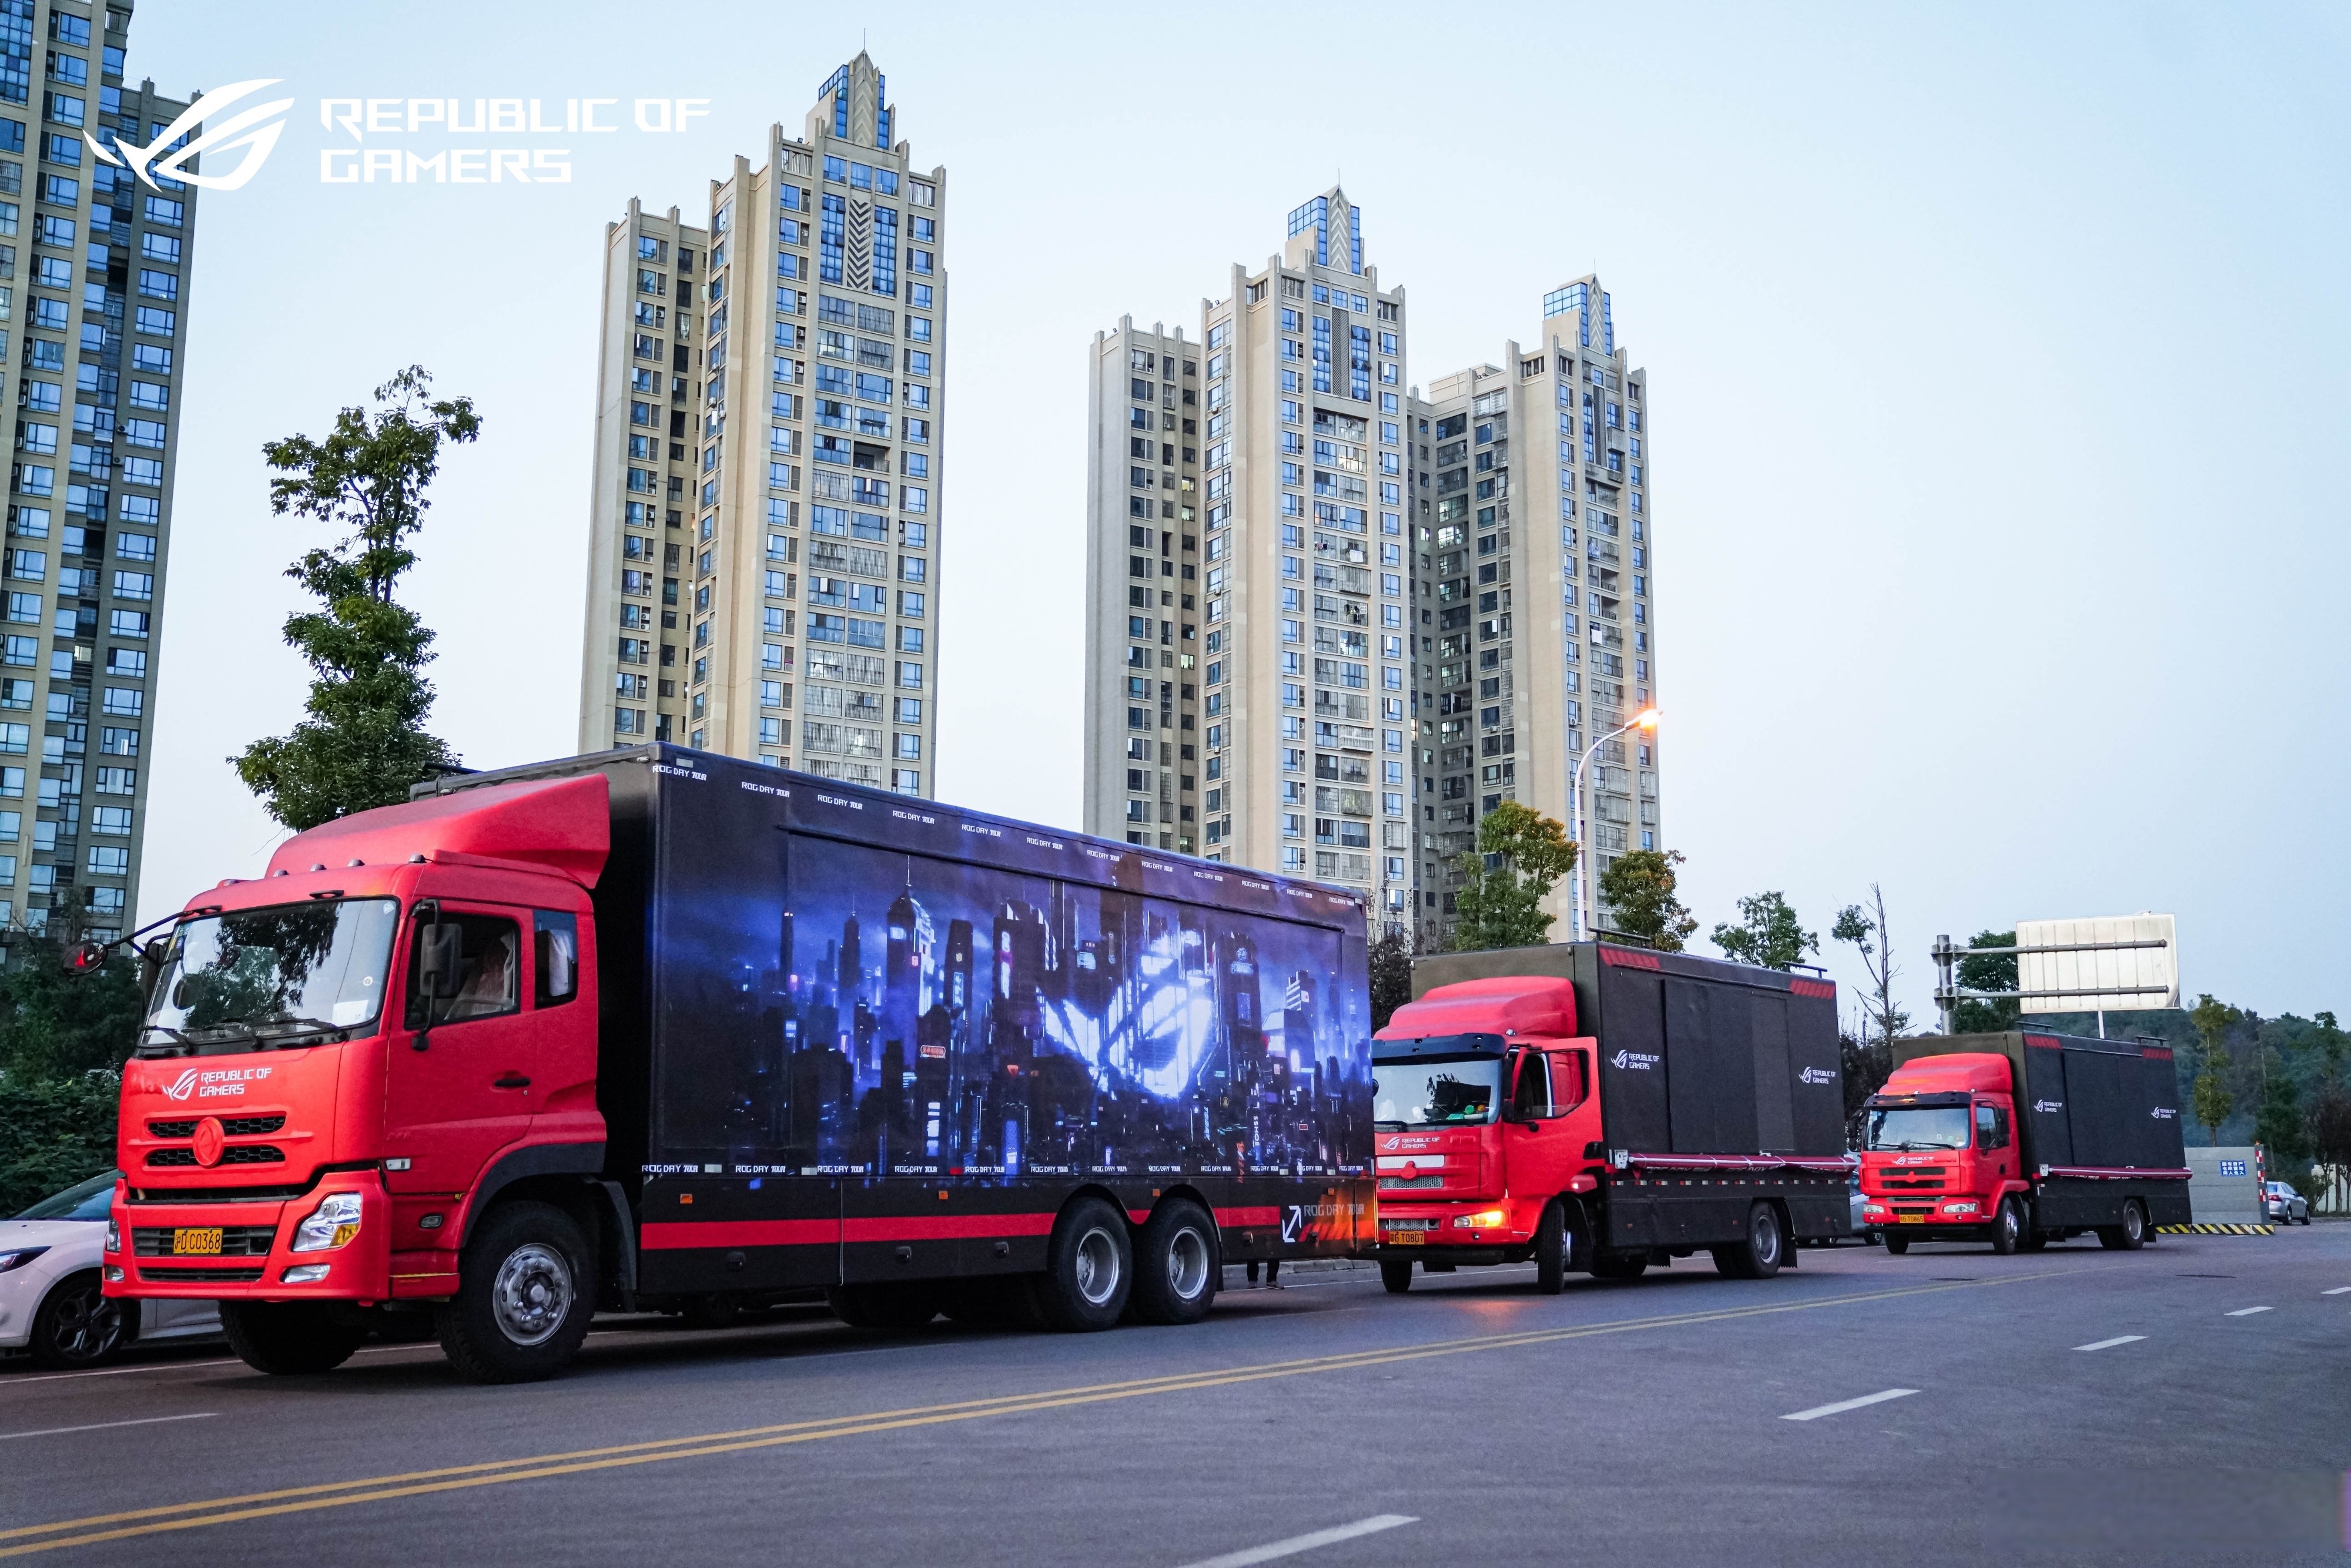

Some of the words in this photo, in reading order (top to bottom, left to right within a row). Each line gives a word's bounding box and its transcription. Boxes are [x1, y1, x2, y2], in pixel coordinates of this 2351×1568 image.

[652, 765, 671, 773] ROG
[674, 768, 689, 777] DAY
[692, 771, 706, 781] TOUR
[742, 782, 758, 791] ROG
[759, 785, 775, 794] DAY
[776, 789, 789, 798] TOUR
[818, 795, 832, 803] ROG
[834, 798, 848, 806] DAY
[849, 801, 862, 810] TOUR
[893, 810, 906, 819] ROG
[962, 824, 974, 832] ROG
[1027, 837, 1038, 845] ROG
[201, 1069, 254, 1085] REPUBLIC
[256, 1068, 272, 1078] OF
[199, 1084, 245, 1097] GAMERS
[1304, 1205, 1324, 1217] ROG
[1327, 1204, 1344, 1215] DAY
